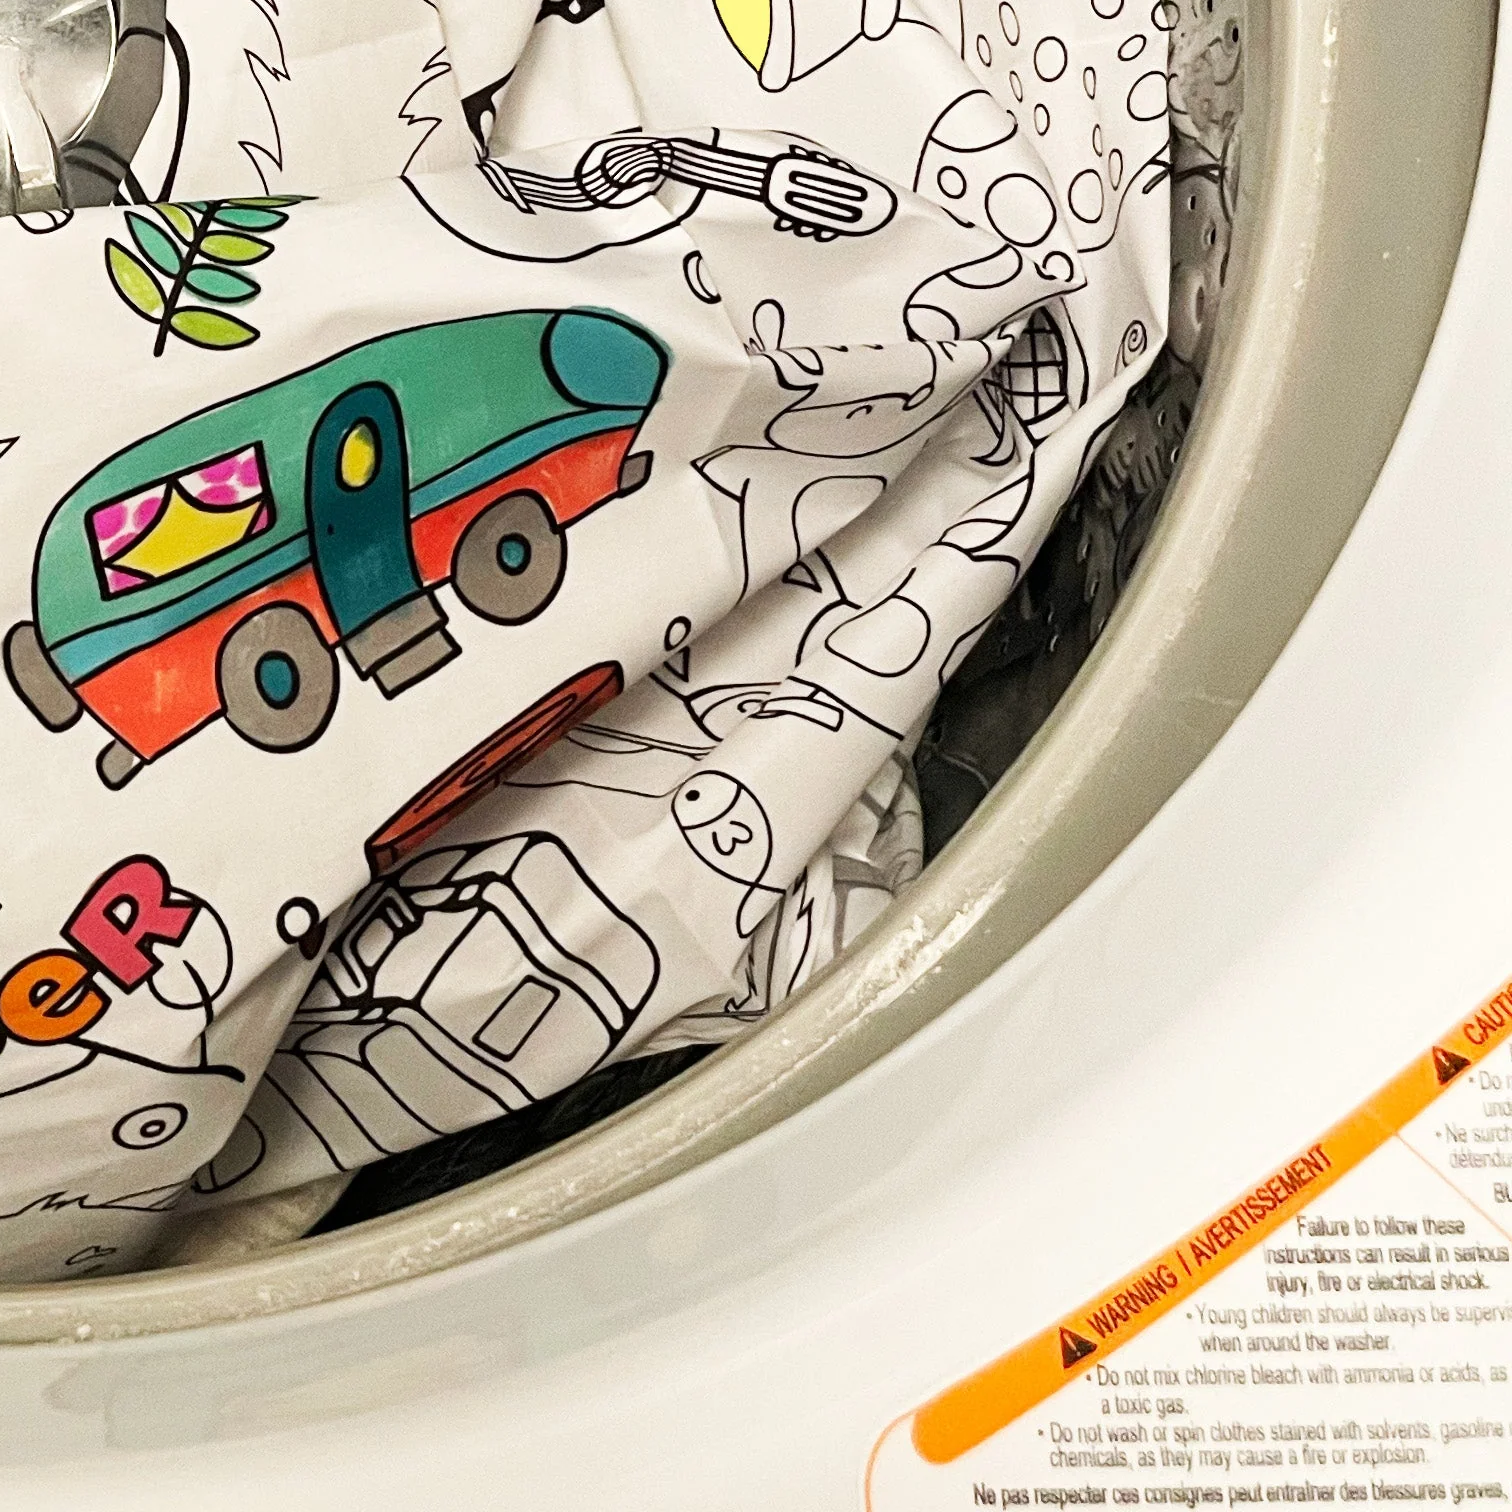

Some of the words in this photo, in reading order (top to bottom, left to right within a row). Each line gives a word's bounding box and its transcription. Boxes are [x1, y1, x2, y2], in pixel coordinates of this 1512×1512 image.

[1296, 1215, 1349, 1236] Failure
[1354, 1216, 1370, 1236] to
[1374, 1215, 1418, 1235] follow
[1422, 1215, 1465, 1235] these
[1086, 1264, 1178, 1339] WARNING
[1188, 1143, 1332, 1267] AVERTISSEMENT
[1356, 1248, 1384, 1263] can
[1388, 1243, 1432, 1263] result
[1437, 1243, 1449, 1263] in
[1454, 1243, 1510, 1263] serious
[1317, 1270, 1341, 1291] fire
[1346, 1274, 1363, 1291] or
[1367, 1269, 1436, 1291] electrical
[1195, 1303, 1248, 1329] Young
[1252, 1302, 1314, 1324] children
[1318, 1301, 1368, 1324] should
[1373, 1302, 1426, 1327] always
[1430, 1302, 1450, 1323] be
[1199, 1332, 1241, 1353] when
[1246, 1332, 1301, 1352] around
[1305, 1331, 1329, 1352] the
[1096, 1364, 1119, 1386] Do
[1124, 1366, 1150, 1386] not
[1154, 1366, 1180, 1386] mix
[1186, 1364, 1246, 1385] chlorine
[1251, 1363, 1303, 1385] bleach
[1307, 1364, 1338, 1384] with
[1343, 1365, 1414, 1384] ammonia
[1419, 1367, 1433, 1383] or
[1490, 1365, 1508, 1382] as
[1101, 1398, 1111, 1415] a
[1114, 1394, 1151, 1415] toxic
[1050, 1421, 1072, 1443] Do
[1078, 1422, 1103, 1443] not
[1107, 1423, 1149, 1443] wash
[1152, 1426, 1168, 1442] or
[1173, 1425, 1204, 1447] spin
[1210, 1420, 1266, 1442] clothes
[1270, 1419, 1326, 1441] stained
[1332, 1419, 1363, 1440] with
[1440, 1417, 1504, 1444] gasoline
[1137, 1451, 1156, 1467] as
[1161, 1447, 1193, 1471] they
[1199, 1451, 1231, 1471] may
[1237, 1447, 1283, 1466] cause
[1289, 1448, 1298, 1465] a
[1302, 1443, 1326, 1465] fire
[1332, 1447, 1348, 1465] or
[973, 1483, 996, 1505] Ne
[1002, 1487, 1030, 1510] pas
[1035, 1485, 1106, 1510] respecter
[1112, 1487, 1138, 1504] ces
[1144, 1485, 1223, 1509] consignes
[1228, 1482, 1263, 1508] peut
[1340, 1481, 1368, 1501] des
[1372, 1479, 1446, 1502] blessures
